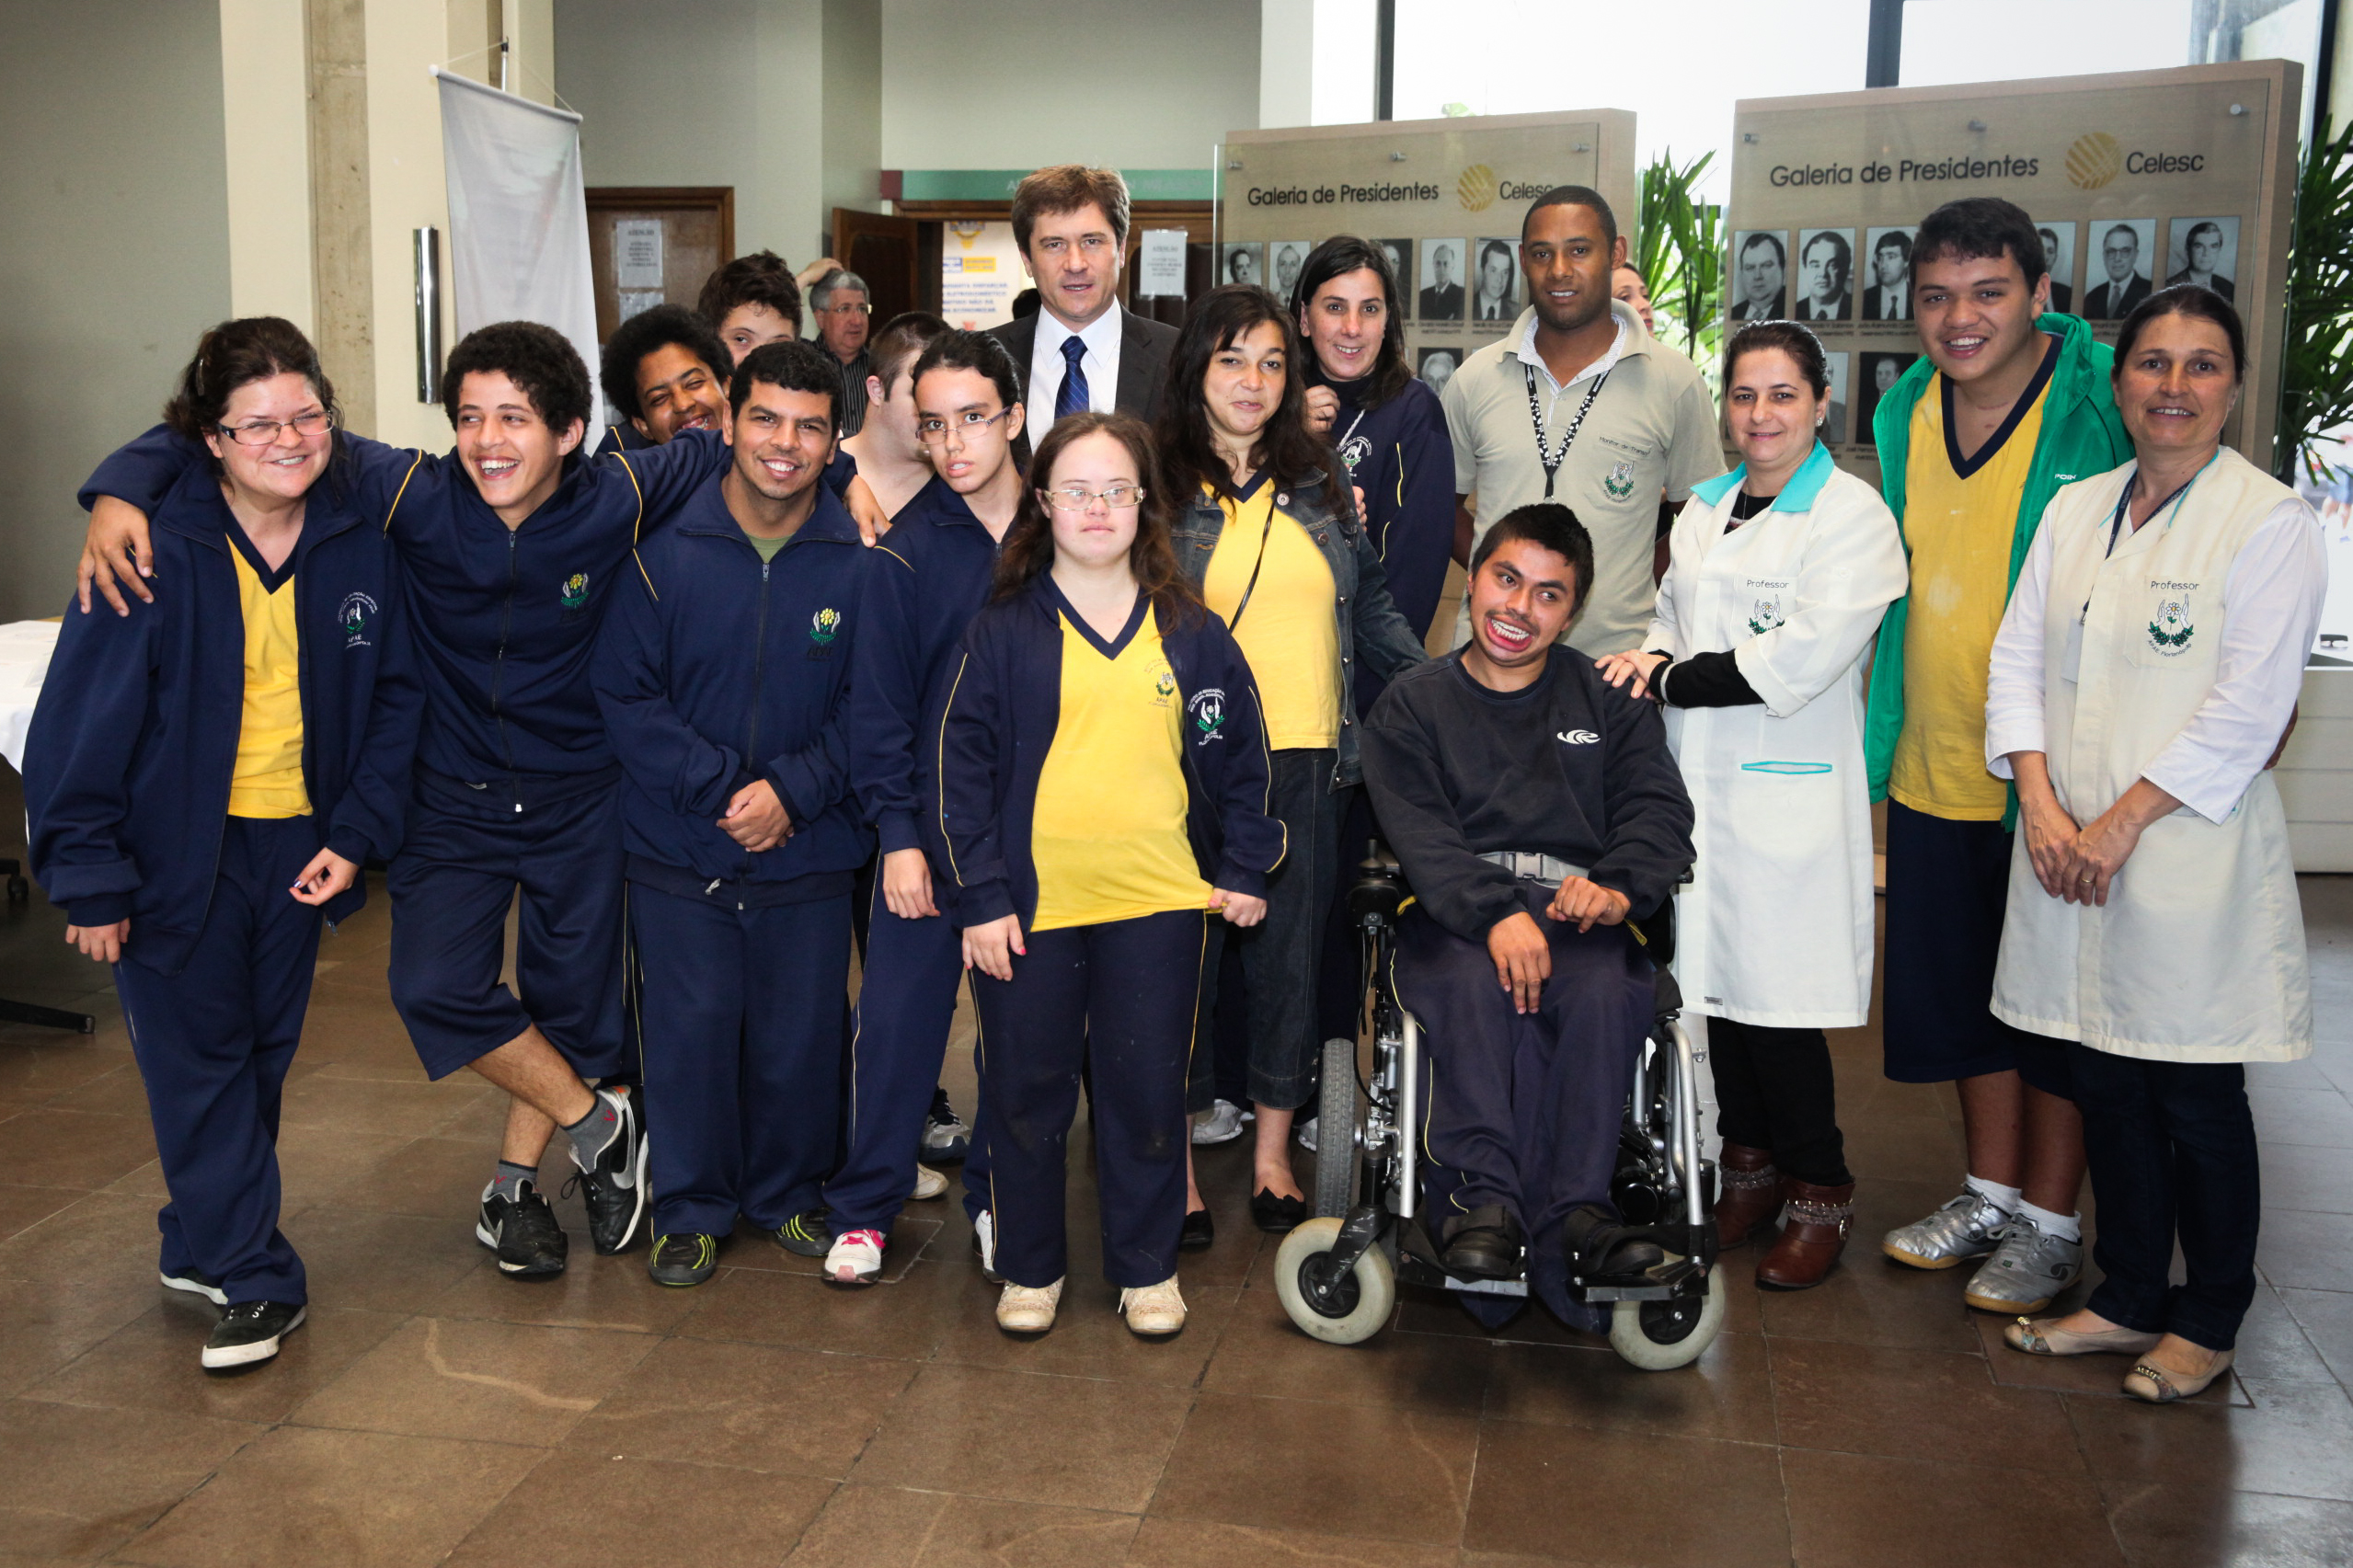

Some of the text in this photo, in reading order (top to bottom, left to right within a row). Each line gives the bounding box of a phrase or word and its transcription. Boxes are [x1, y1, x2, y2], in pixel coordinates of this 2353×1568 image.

[1769, 151, 2205, 187] Galeria de Presidentes Celesc
[1247, 186, 1308, 207] Galeria
[1313, 186, 1336, 204] de
[1340, 181, 1439, 203] Presidentes
[1599, 436, 1619, 446] Monitor
[1747, 579, 1789, 589] Professor
[2151, 580, 2199, 589] Professor
